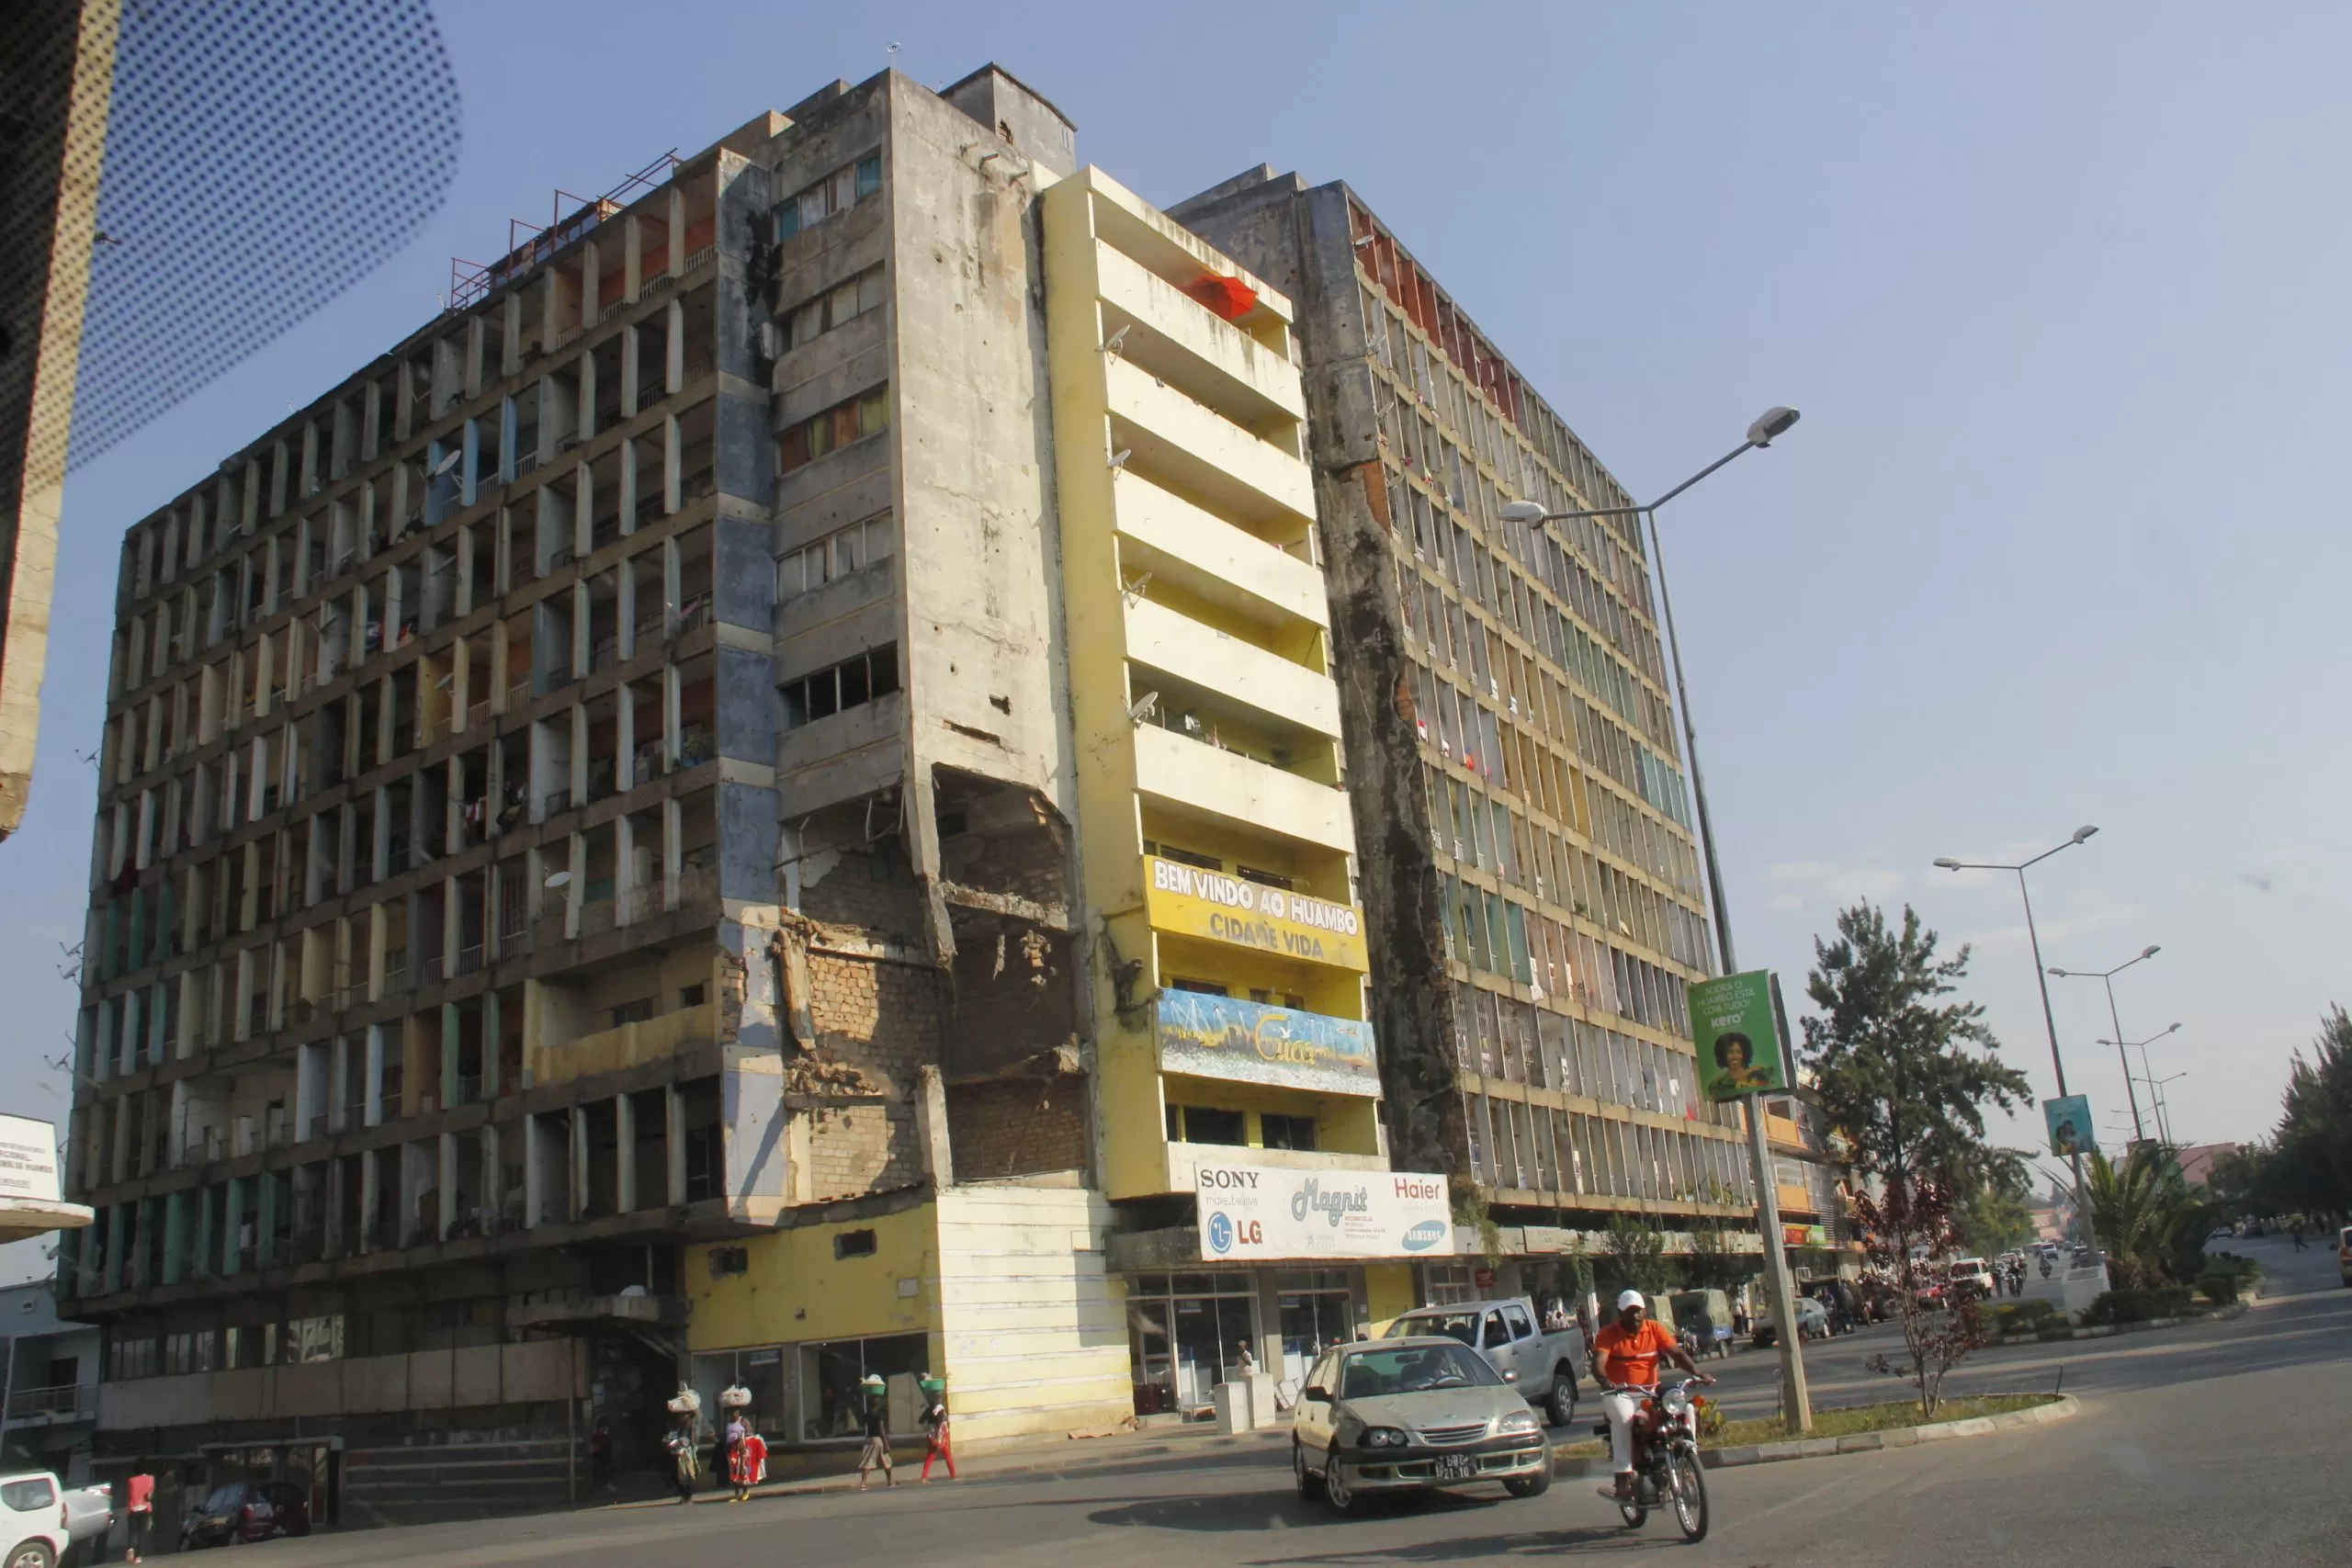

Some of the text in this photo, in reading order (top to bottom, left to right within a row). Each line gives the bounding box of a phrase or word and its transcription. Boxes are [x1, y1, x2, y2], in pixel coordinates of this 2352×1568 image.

[1154, 860, 1358, 936] BEM VINDO AO HUAMBO
[1283, 930, 1324, 959] VIDA
[1200, 1168, 1260, 1189] SONY
[1394, 1178, 1440, 1200] Haier
[1291, 1178, 1368, 1227] Magnit
[1237, 1220, 1263, 1245] LG
[1407, 1228, 1442, 1243] SAMSUNG
